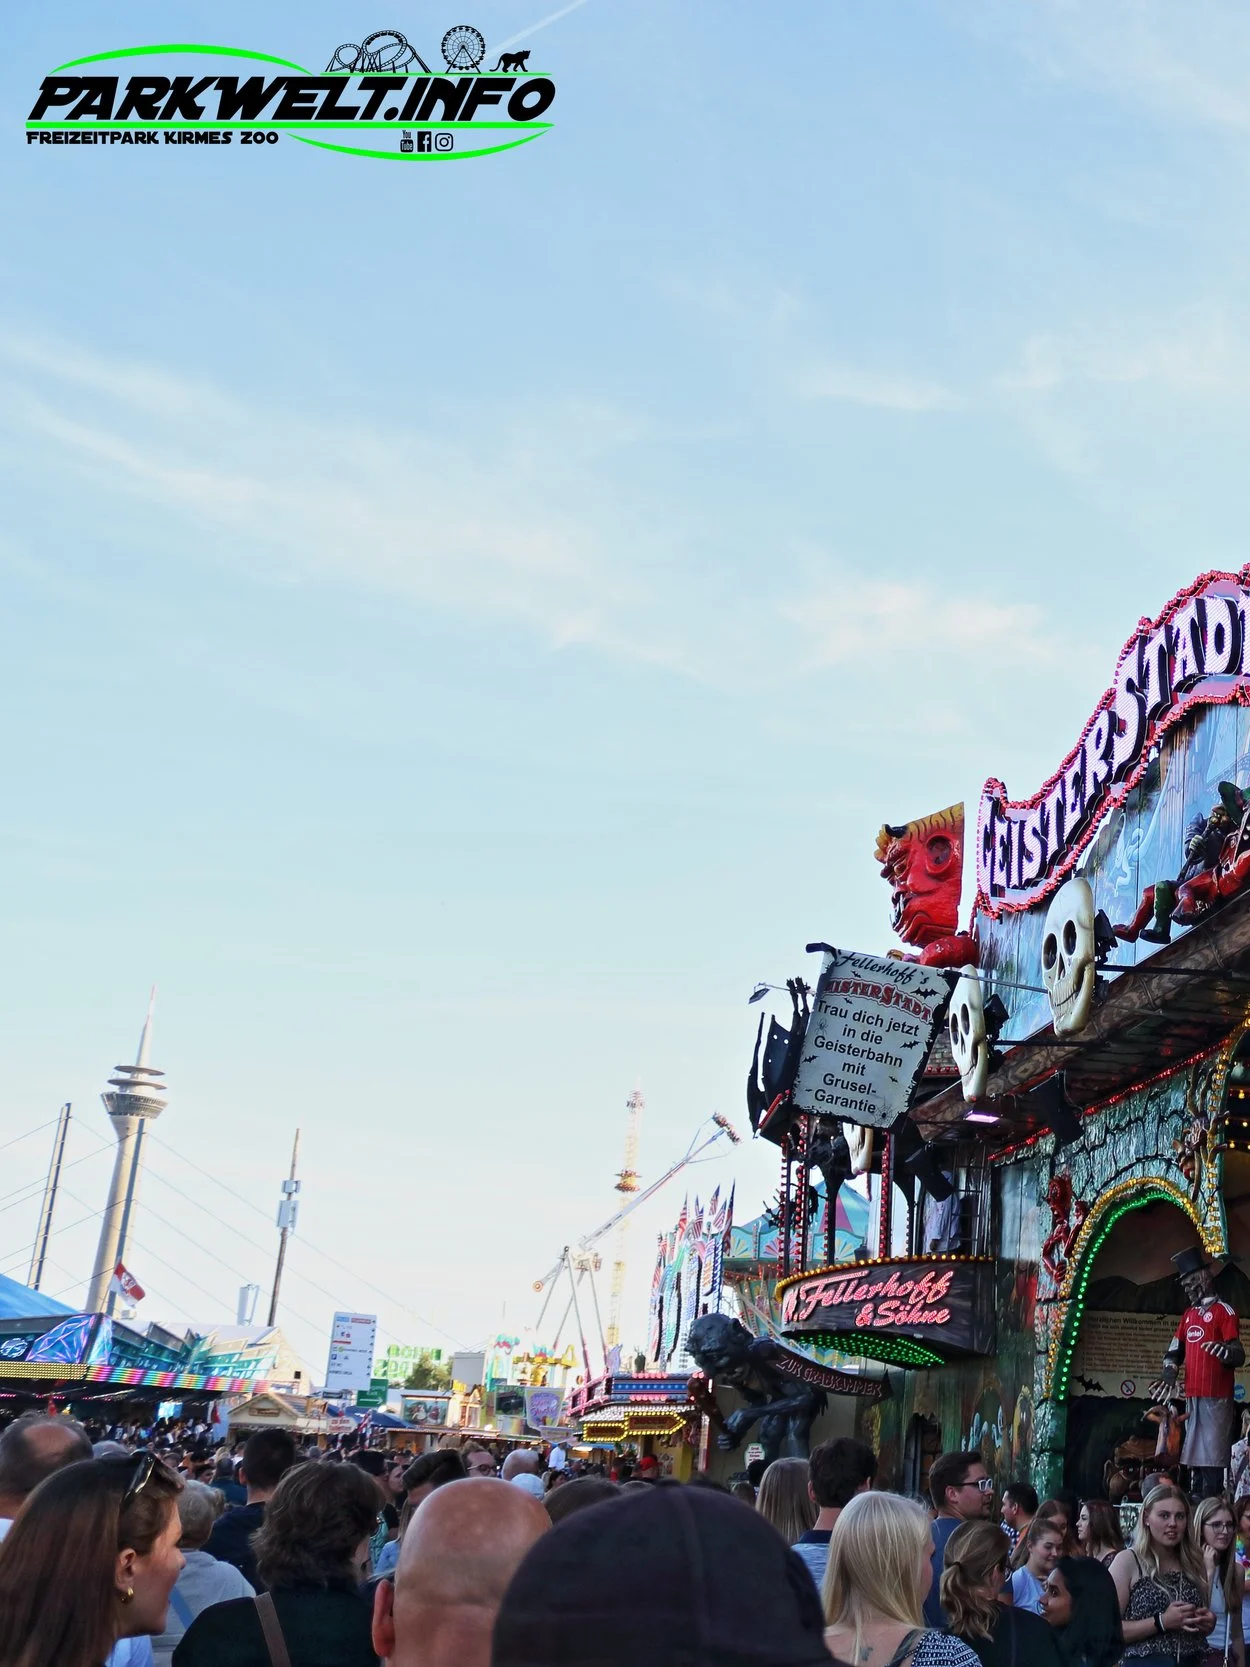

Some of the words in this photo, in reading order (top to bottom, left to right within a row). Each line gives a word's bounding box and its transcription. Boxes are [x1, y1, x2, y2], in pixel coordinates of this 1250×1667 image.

[824, 980, 932, 1022] EISTERSTADT
[817, 1000, 849, 1018] Trau
[852, 1010, 884, 1028] dich
[886, 1017, 920, 1037] jetzt
[842, 1024, 857, 1038] in
[861, 1028, 883, 1045] die
[814, 1036, 903, 1068] Geisterbahn
[842, 1061, 865, 1076] mit
[823, 1073, 877, 1096] Grusel-
[814, 1089, 876, 1114] Garantie
[800, 1270, 953, 1320] Fellerhoff
[855, 1303, 875, 1327] &
[874, 1300, 951, 1327] Söhne
[776, 1355, 803, 1377] ZUR
